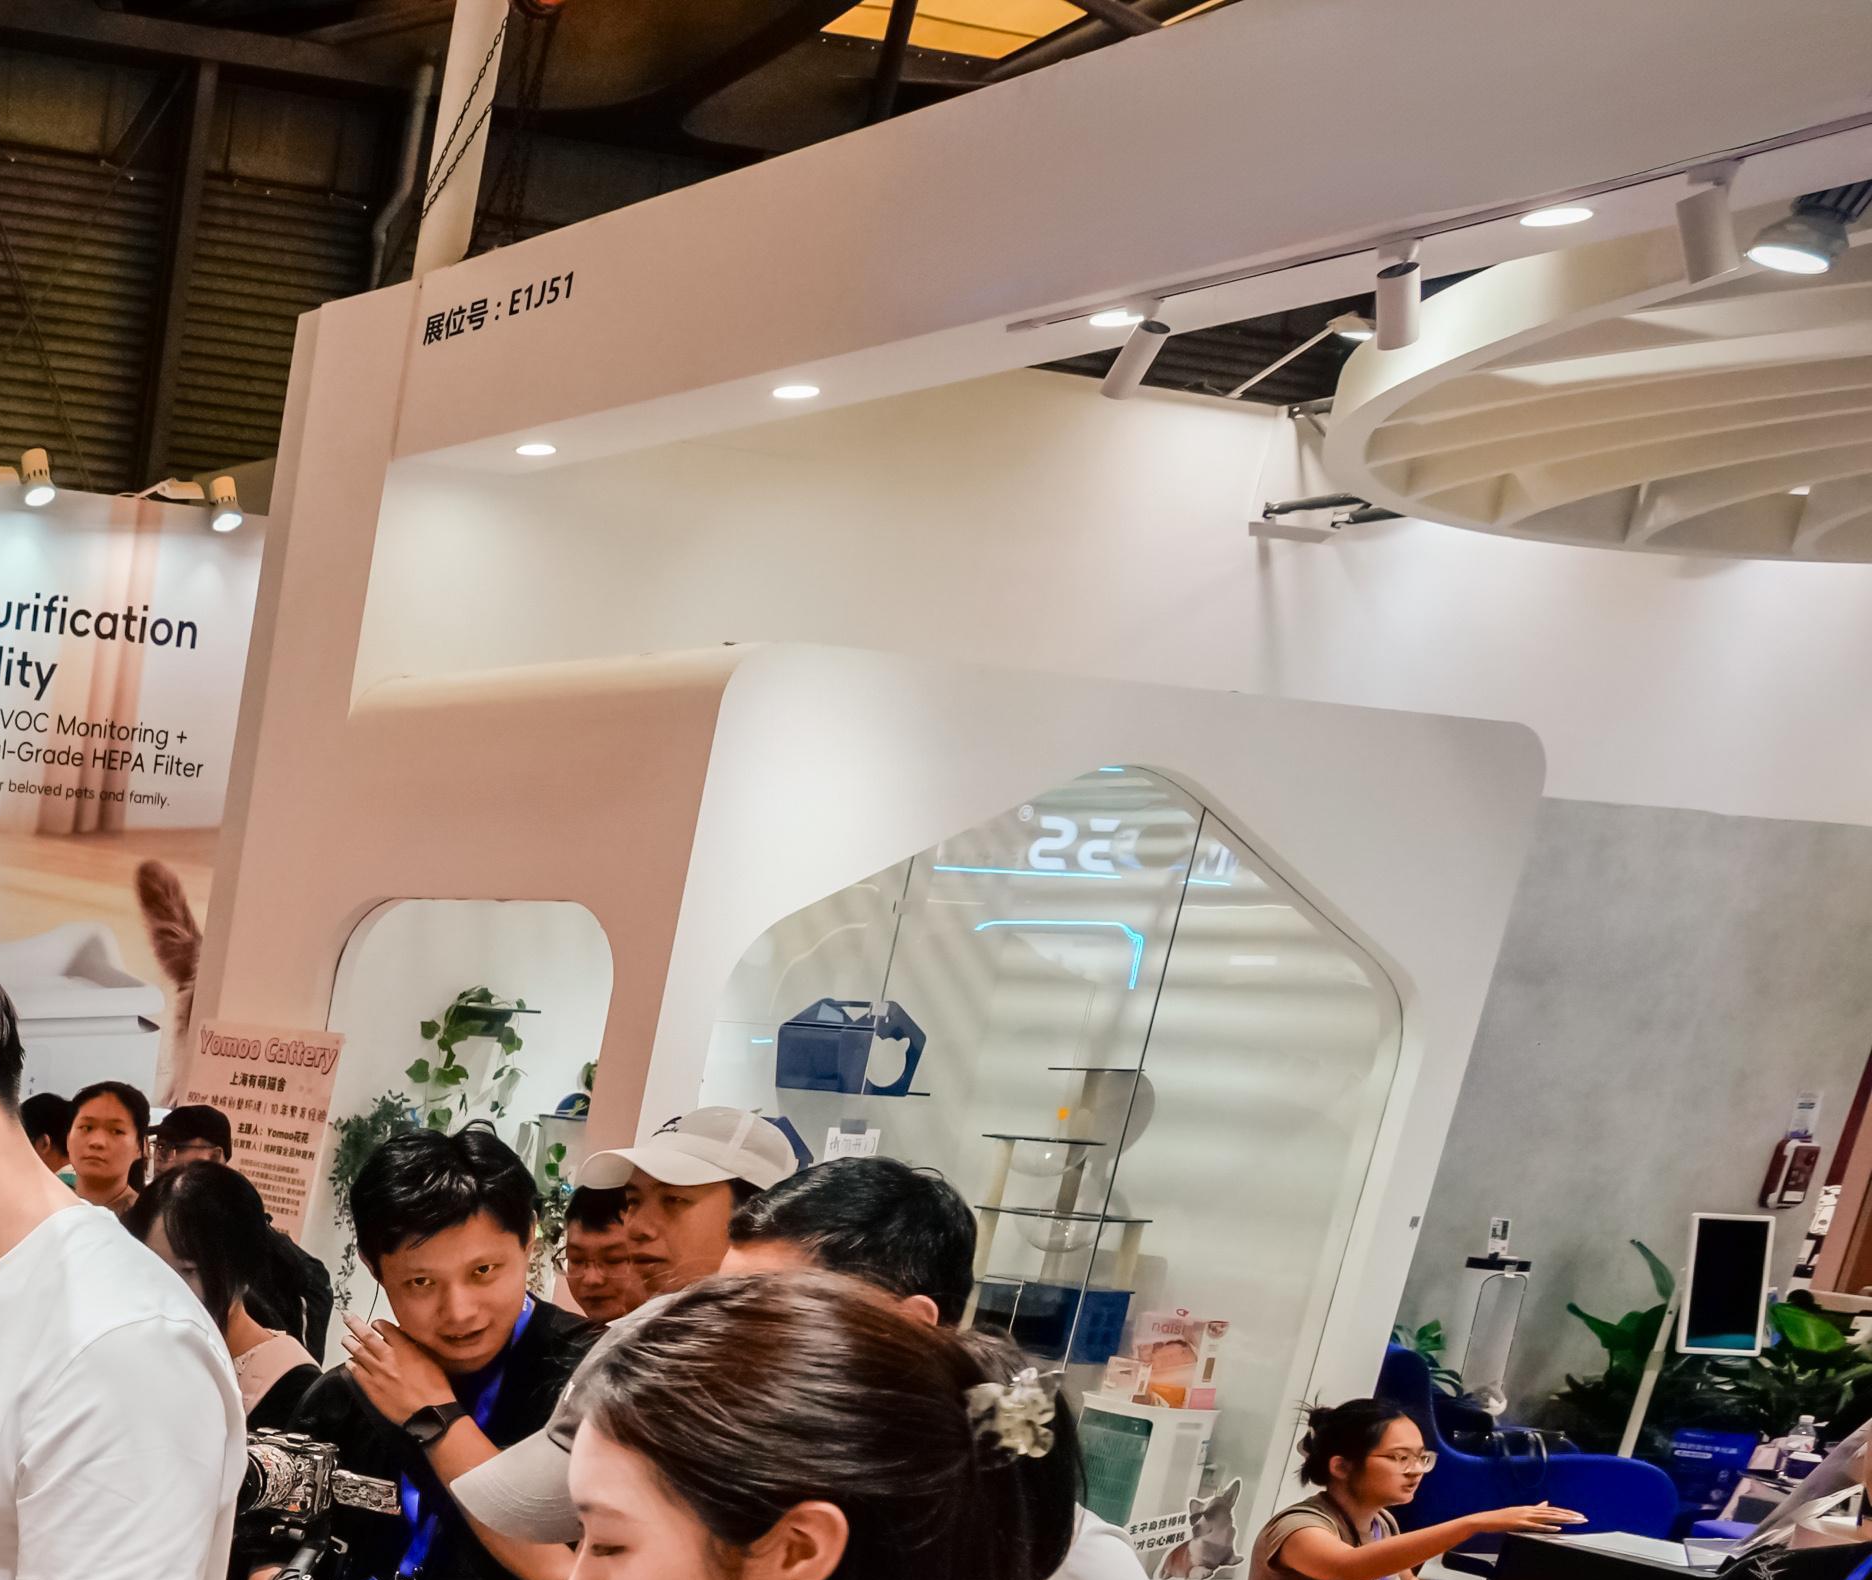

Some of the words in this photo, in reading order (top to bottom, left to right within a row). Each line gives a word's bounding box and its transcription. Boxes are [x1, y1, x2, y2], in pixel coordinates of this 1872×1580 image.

[56, 713, 170, 749] Monitoring
[91, 745, 145, 774] HEPA
[152, 752, 204, 780] Filter
[7, 778, 62, 799] beloved
[65, 785, 96, 804] pets
[99, 785, 125, 802] and
[128, 788, 171, 808] family.
[200, 1030, 260, 1060] Yomoo
[264, 1037, 338, 1075] Cattery
